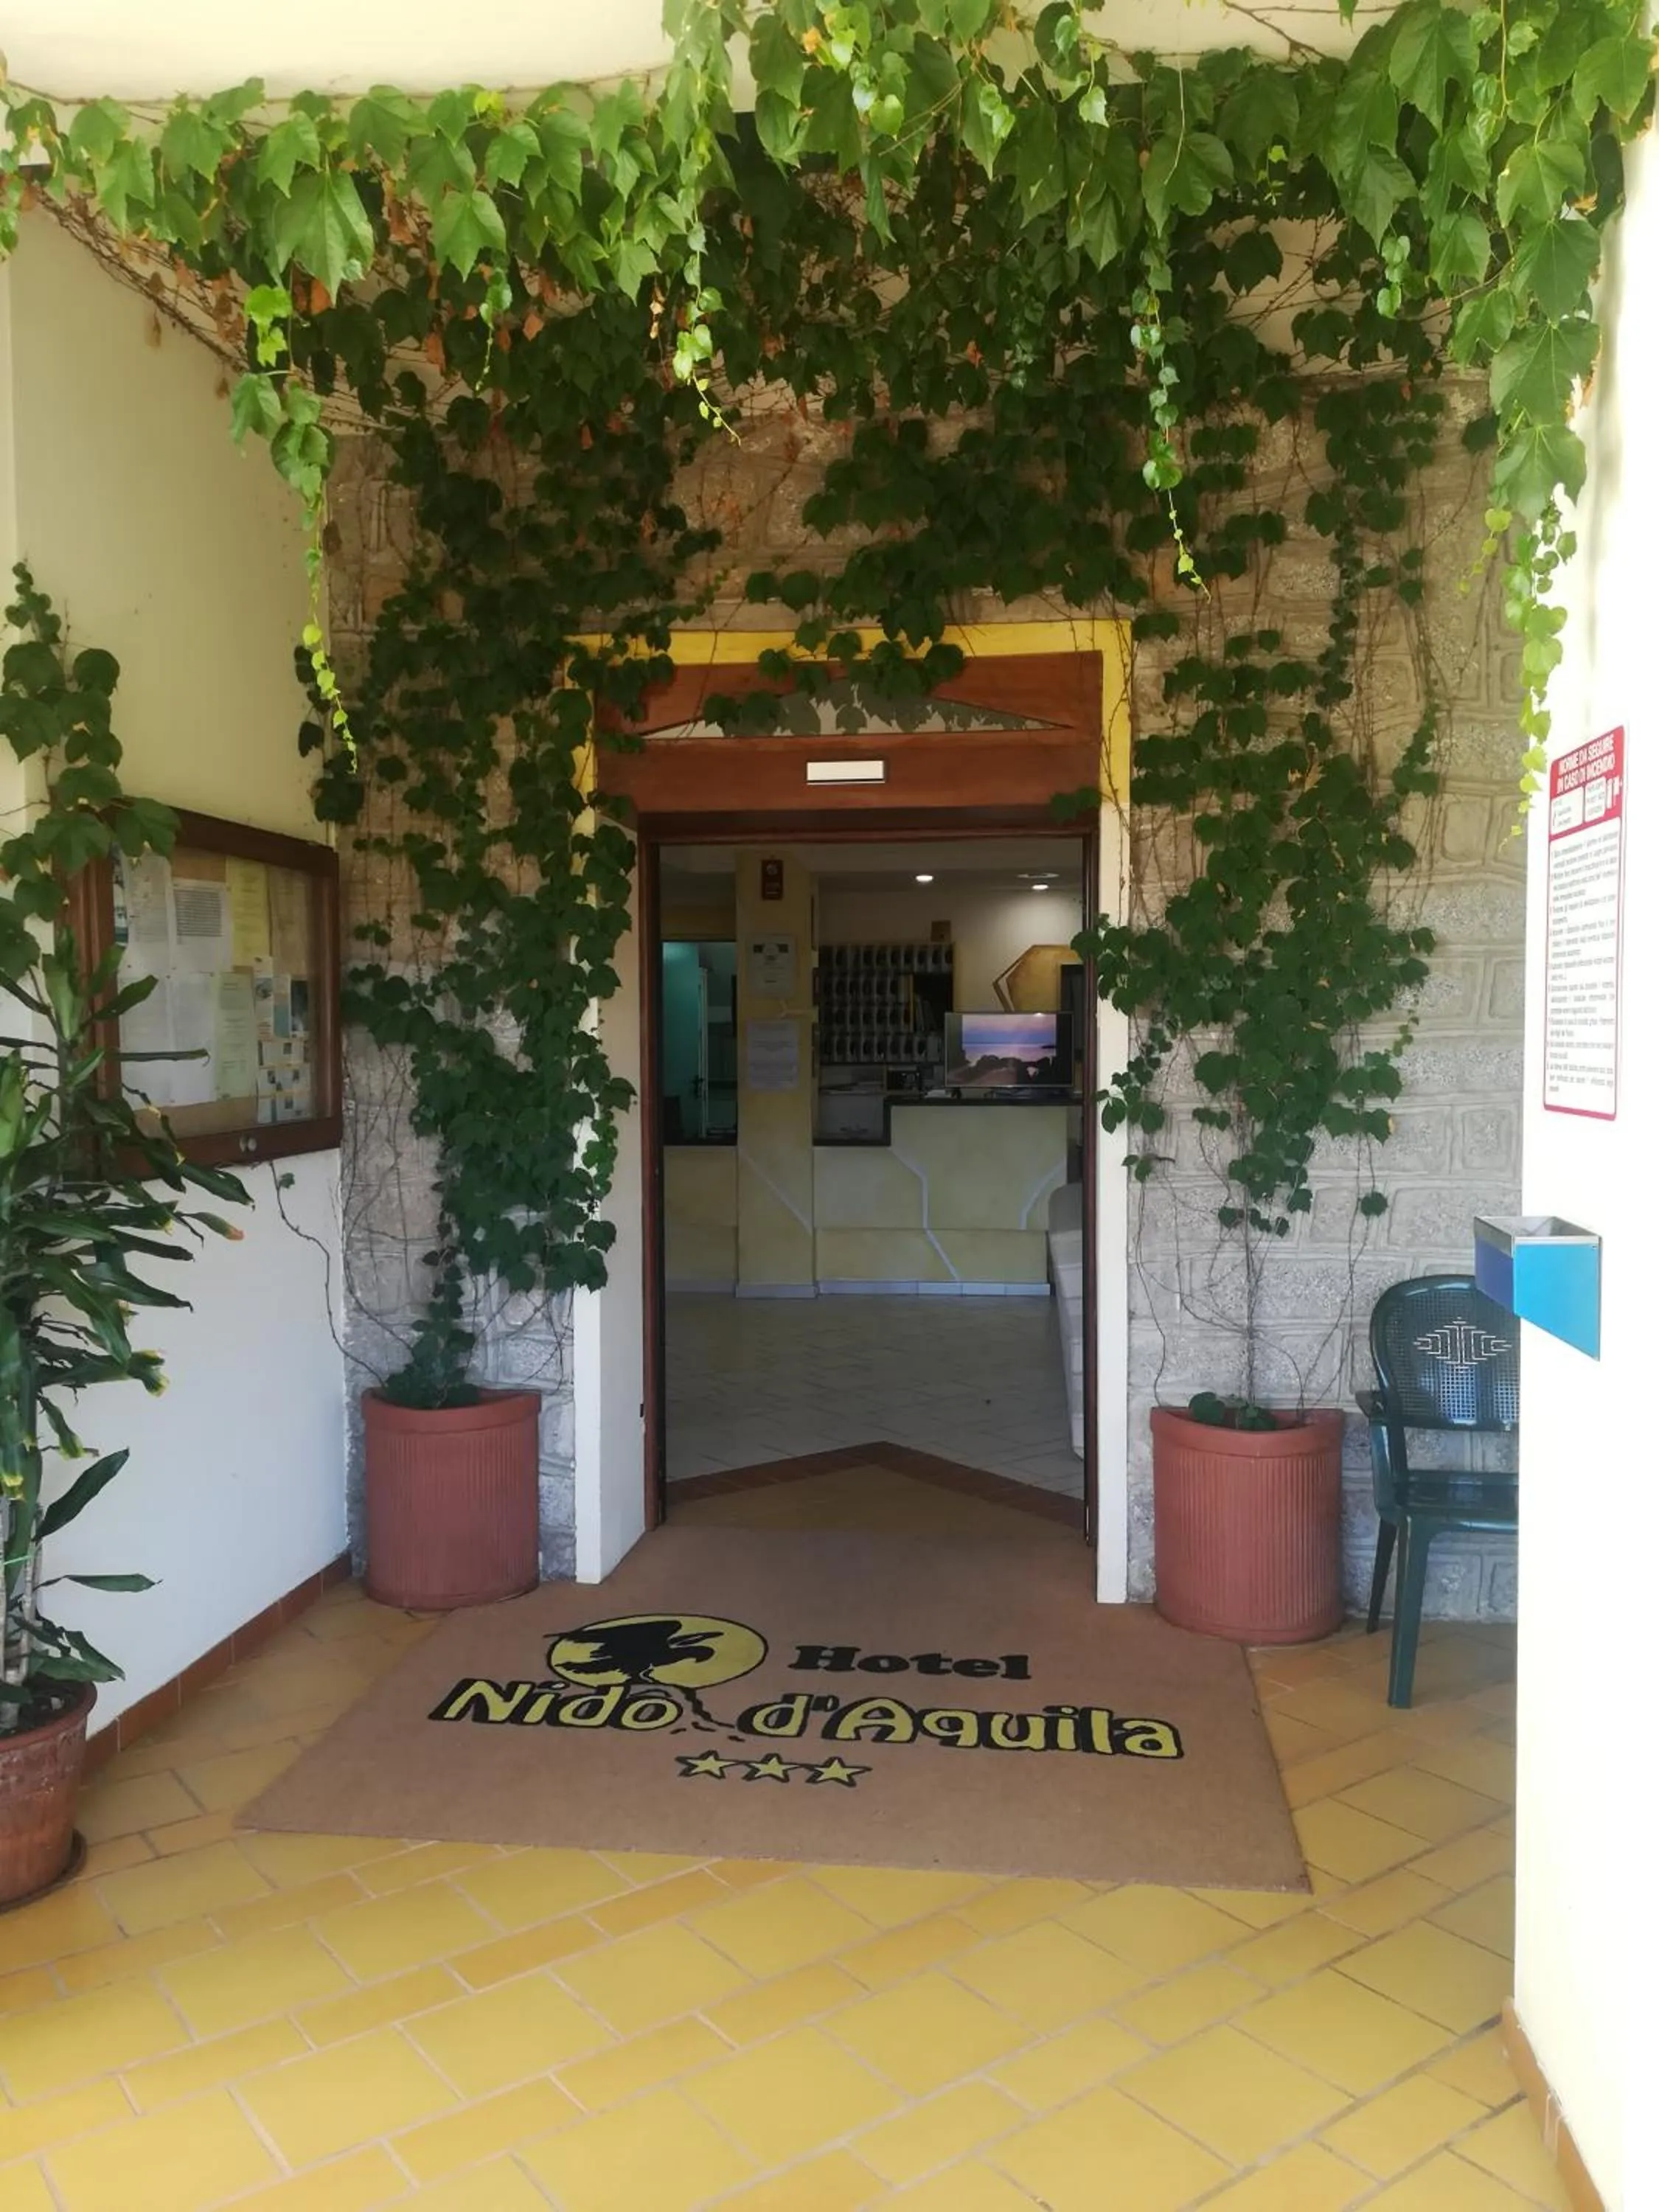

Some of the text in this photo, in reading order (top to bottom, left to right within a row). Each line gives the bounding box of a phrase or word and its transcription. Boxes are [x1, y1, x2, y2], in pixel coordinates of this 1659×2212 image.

[1587, 734, 1614, 760] SEGUIRE
[788, 1645, 1032, 1680] Hotel
[429, 1678, 1184, 1759] Nido d'Aquila
